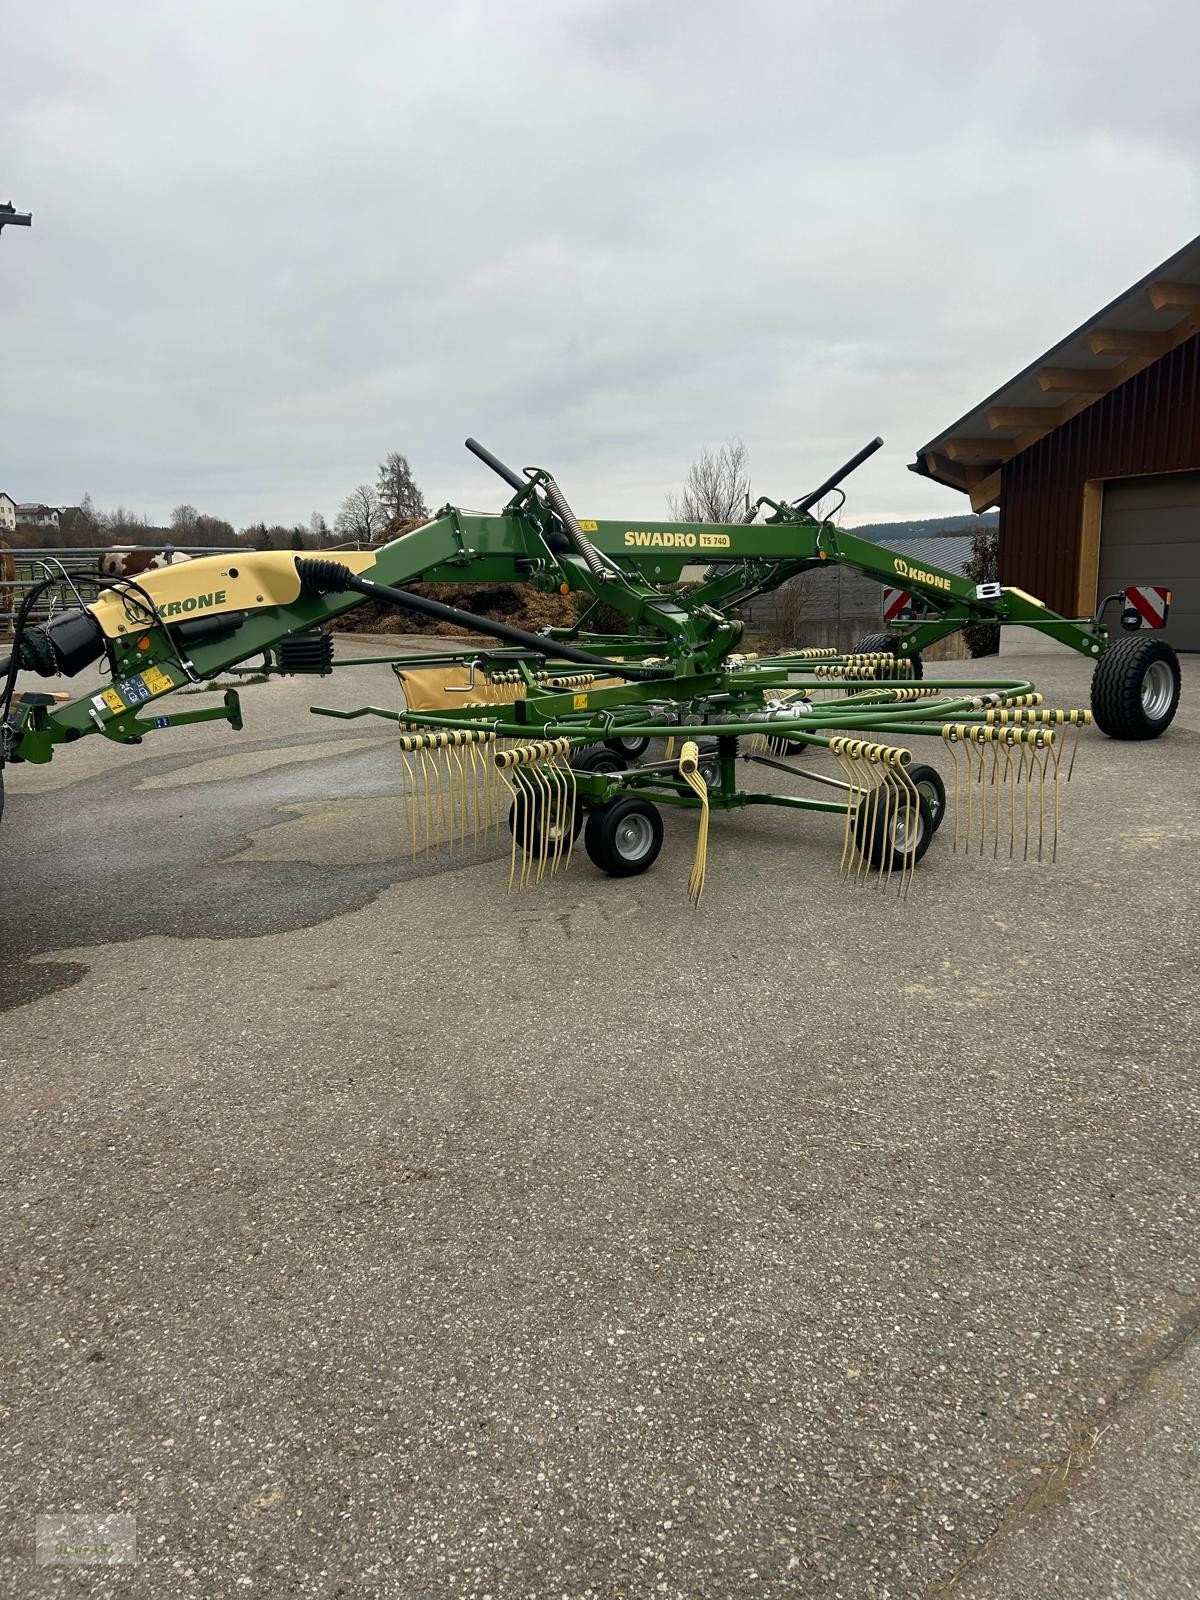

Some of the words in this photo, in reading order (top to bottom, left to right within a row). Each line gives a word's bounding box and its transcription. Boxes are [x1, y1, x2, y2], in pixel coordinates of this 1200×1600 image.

[624, 531, 697, 548] SWADRO
[702, 537, 712, 545] TS
[713, 537, 727, 546] 740
[908, 567, 952, 591] KRONE
